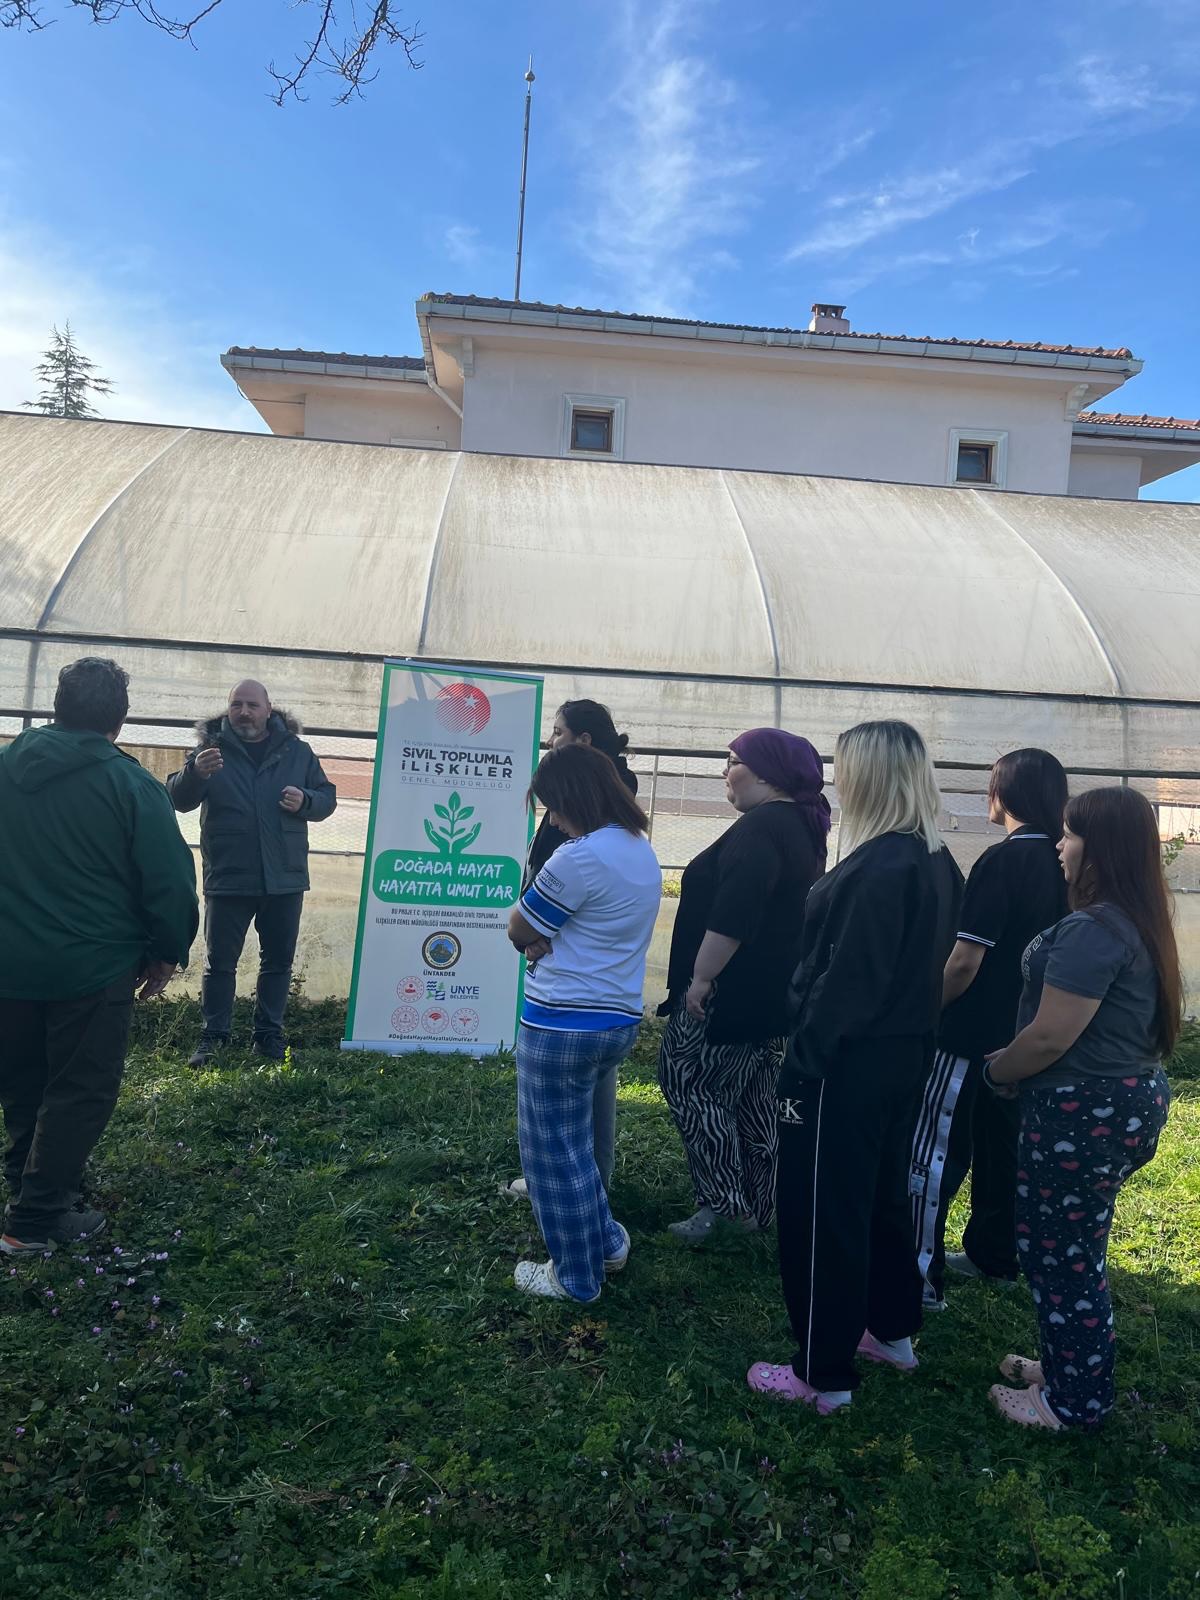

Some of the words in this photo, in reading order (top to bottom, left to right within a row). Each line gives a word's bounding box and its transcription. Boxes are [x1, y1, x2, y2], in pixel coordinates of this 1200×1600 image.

[440, 750, 513, 766] TOPLUMLA
[401, 760, 513, 779] İLİŞKİLER
[401, 776, 437, 785] GENEL
[394, 857, 453, 877] DOĞADA
[457, 862, 504, 879] HAYAT
[379, 879, 442, 897] HAYATTA
[446, 883, 484, 899] UMUT
[486, 885, 514, 901] VAR
